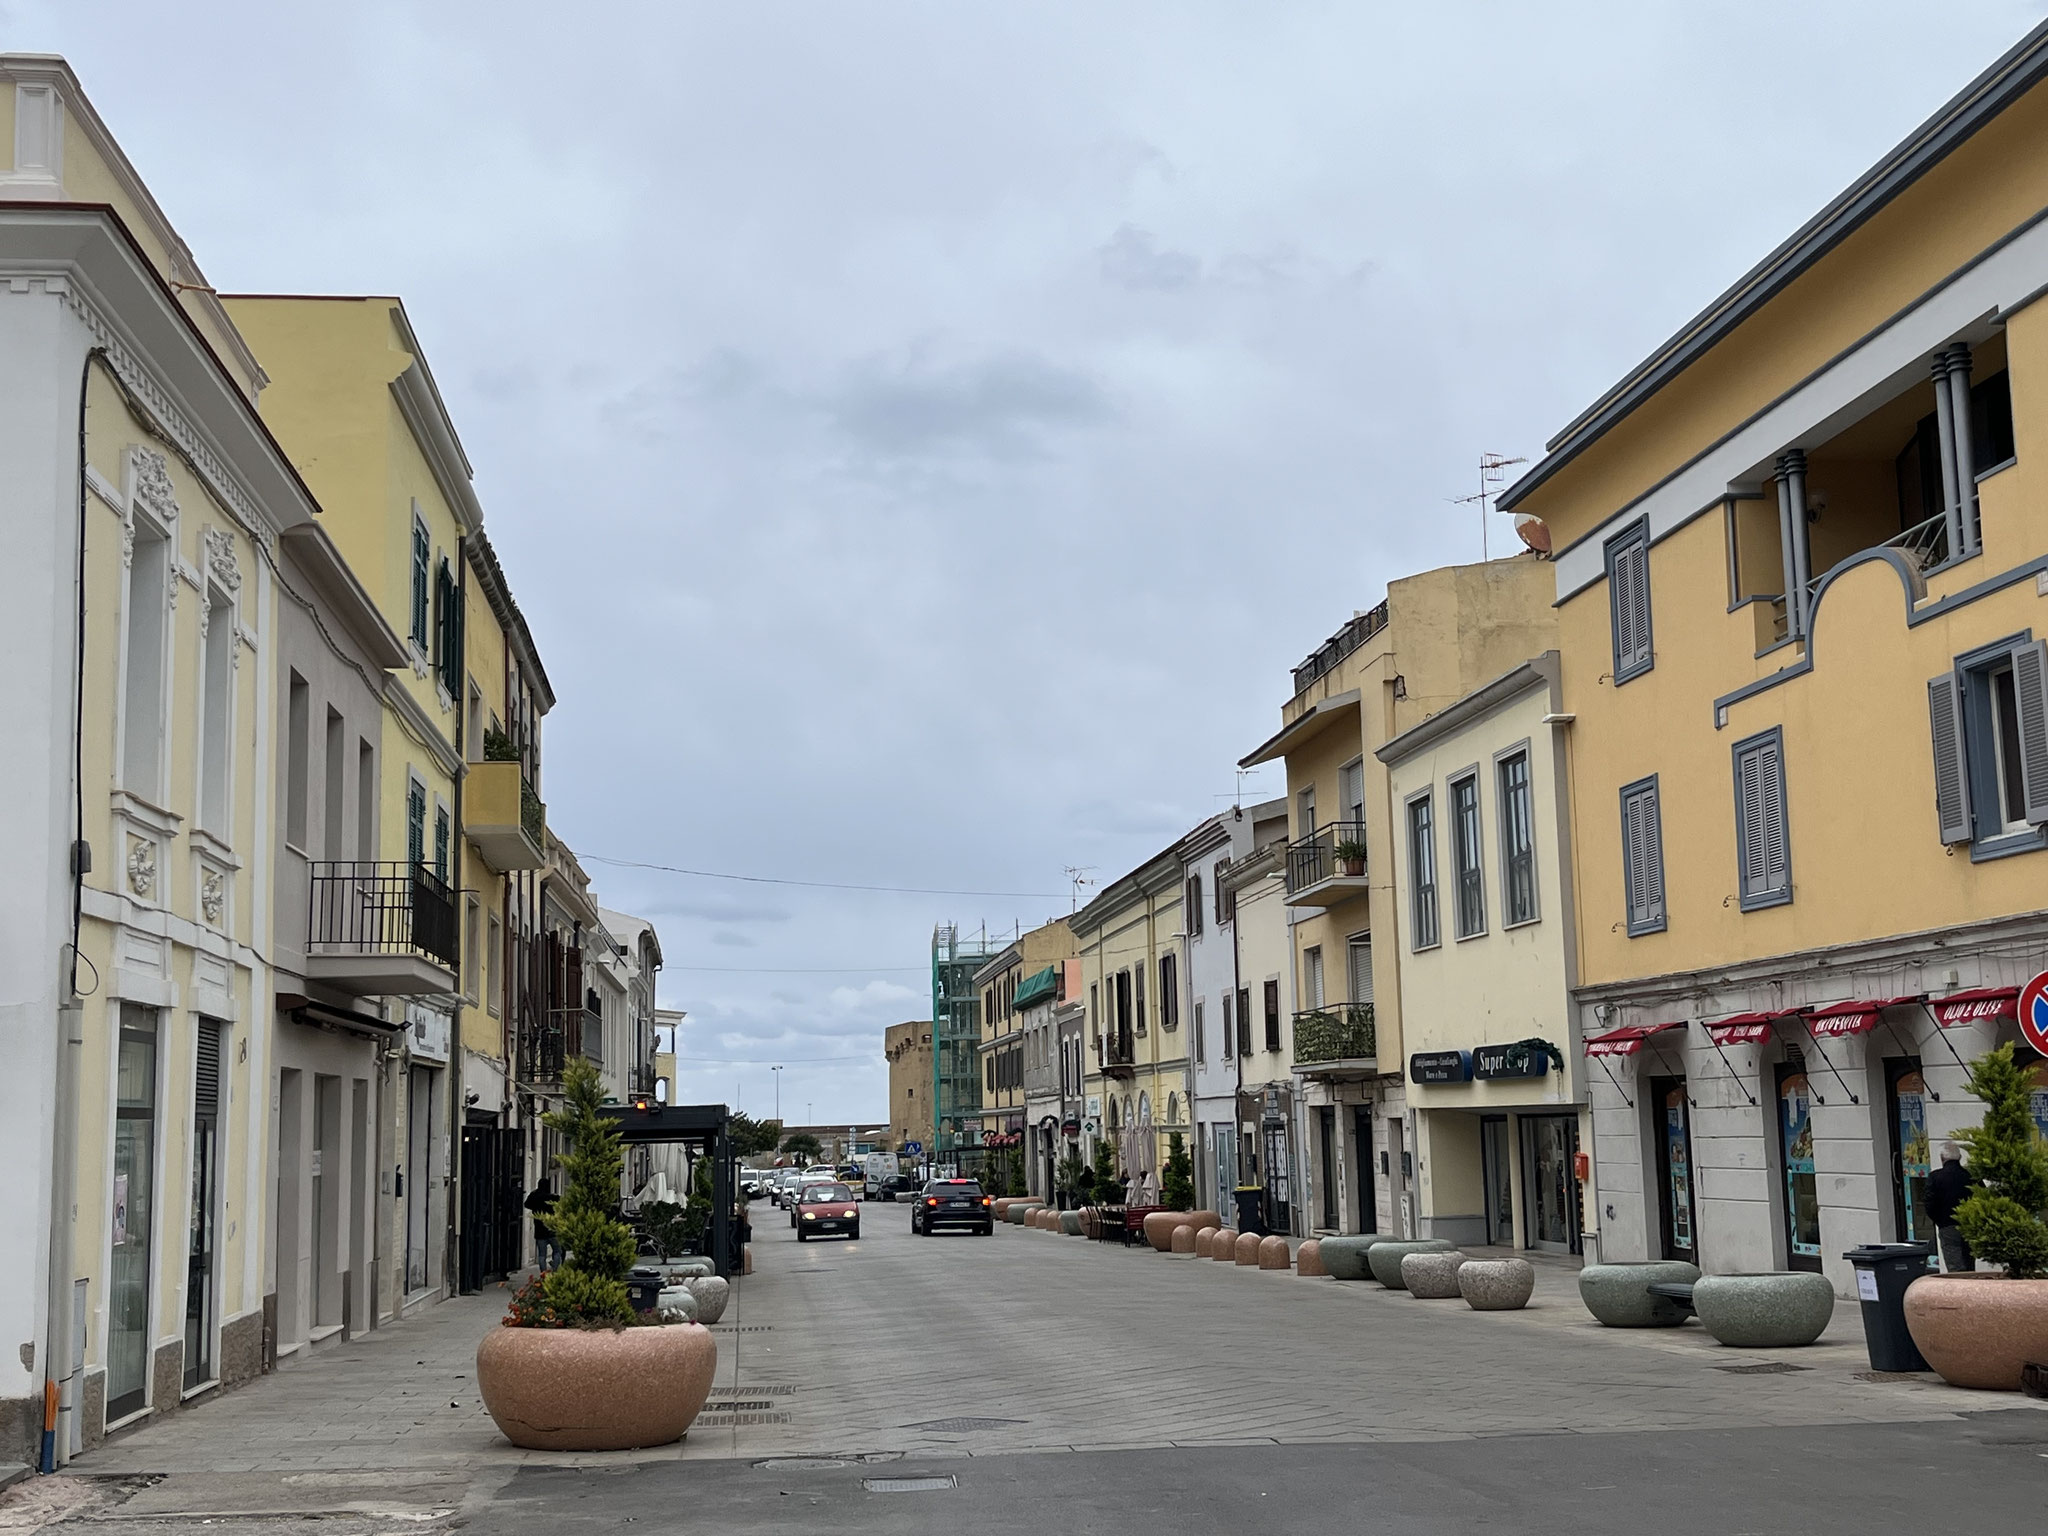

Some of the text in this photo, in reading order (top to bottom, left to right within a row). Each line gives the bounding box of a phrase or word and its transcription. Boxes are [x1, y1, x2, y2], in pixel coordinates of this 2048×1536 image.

[1943, 999, 2005, 1020] OLIO E OLIVE
[1479, 1051, 1504, 1076] Super
